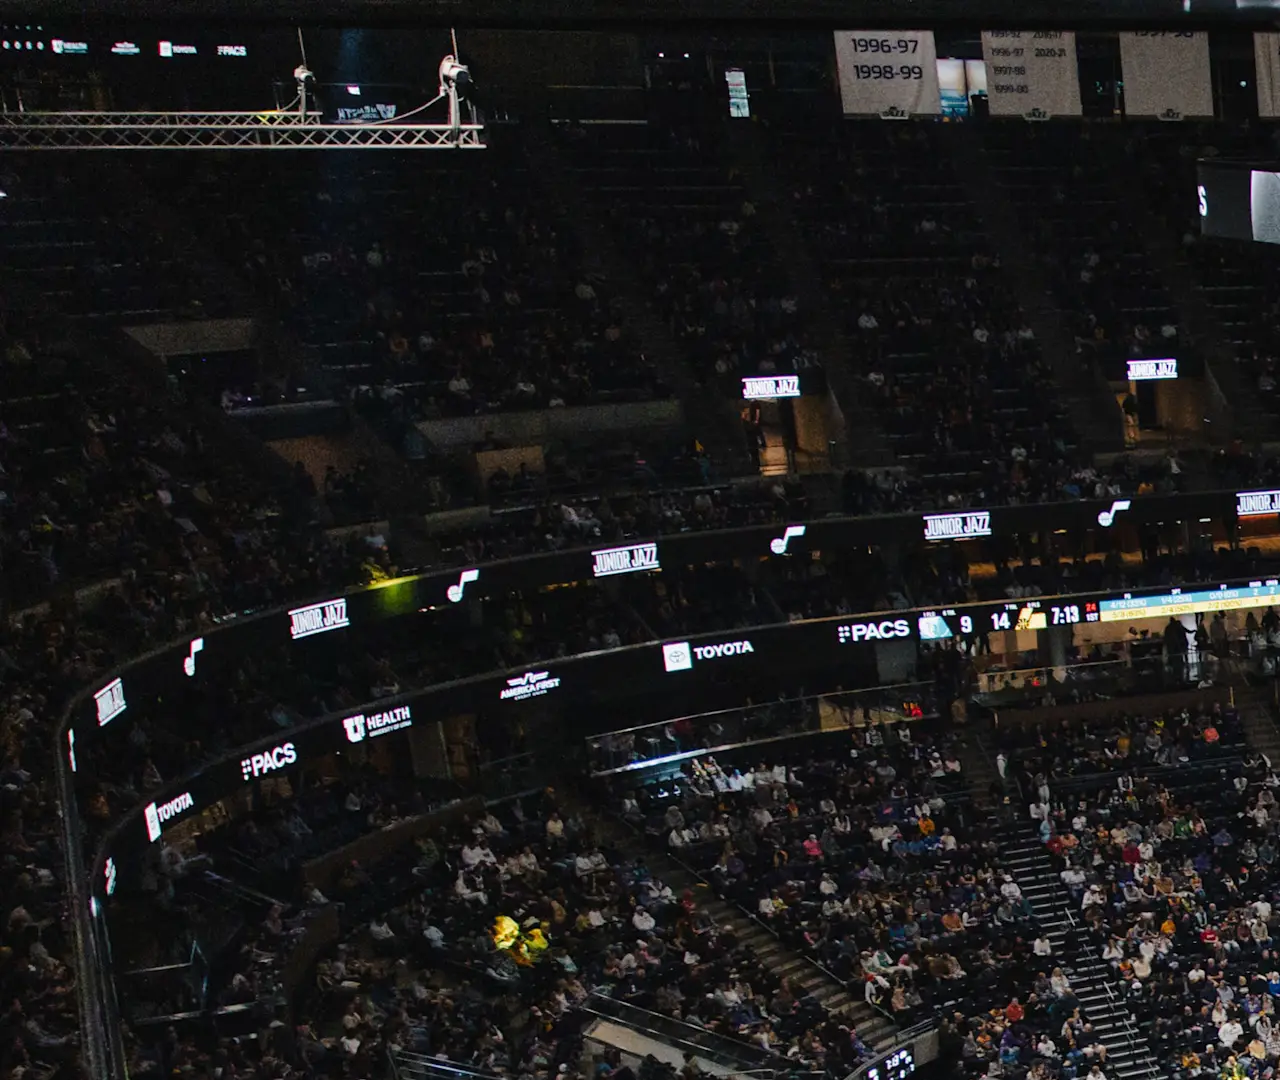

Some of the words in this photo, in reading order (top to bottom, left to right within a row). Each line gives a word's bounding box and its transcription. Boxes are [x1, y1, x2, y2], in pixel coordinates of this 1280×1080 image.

[852, 39, 918, 54] 1996-97
[854, 65, 922, 80] 1998-99
[743, 380, 775, 395] JUNIOR
[778, 379, 800, 393] JAZZ
[1237, 496, 1269, 512] JUNIOR
[924, 518, 962, 536] JUNIOR
[965, 516, 991, 532] JAZZ
[593, 552, 630, 572] JUNIOR
[632, 546, 659, 566] JAZZ
[1086, 603, 1096, 612] 24
[1086, 613, 1098, 621] 1ST
[291, 608, 323, 635] JUNIOR
[324, 602, 348, 625] JAZZ
[852, 620, 909, 641] PACS
[961, 616, 972, 633] 9
[991, 613, 1010, 630] 14
[1052, 607, 1079, 624] 7:13
[694, 641, 754, 659] TOYOTA
[500, 684, 534, 699] AMERICA
[536, 678, 560, 691] FIRST
[367, 706, 410, 730] HEALTH
[252, 743, 296, 776] PACS
[157, 793, 193, 822] TOYOTA
